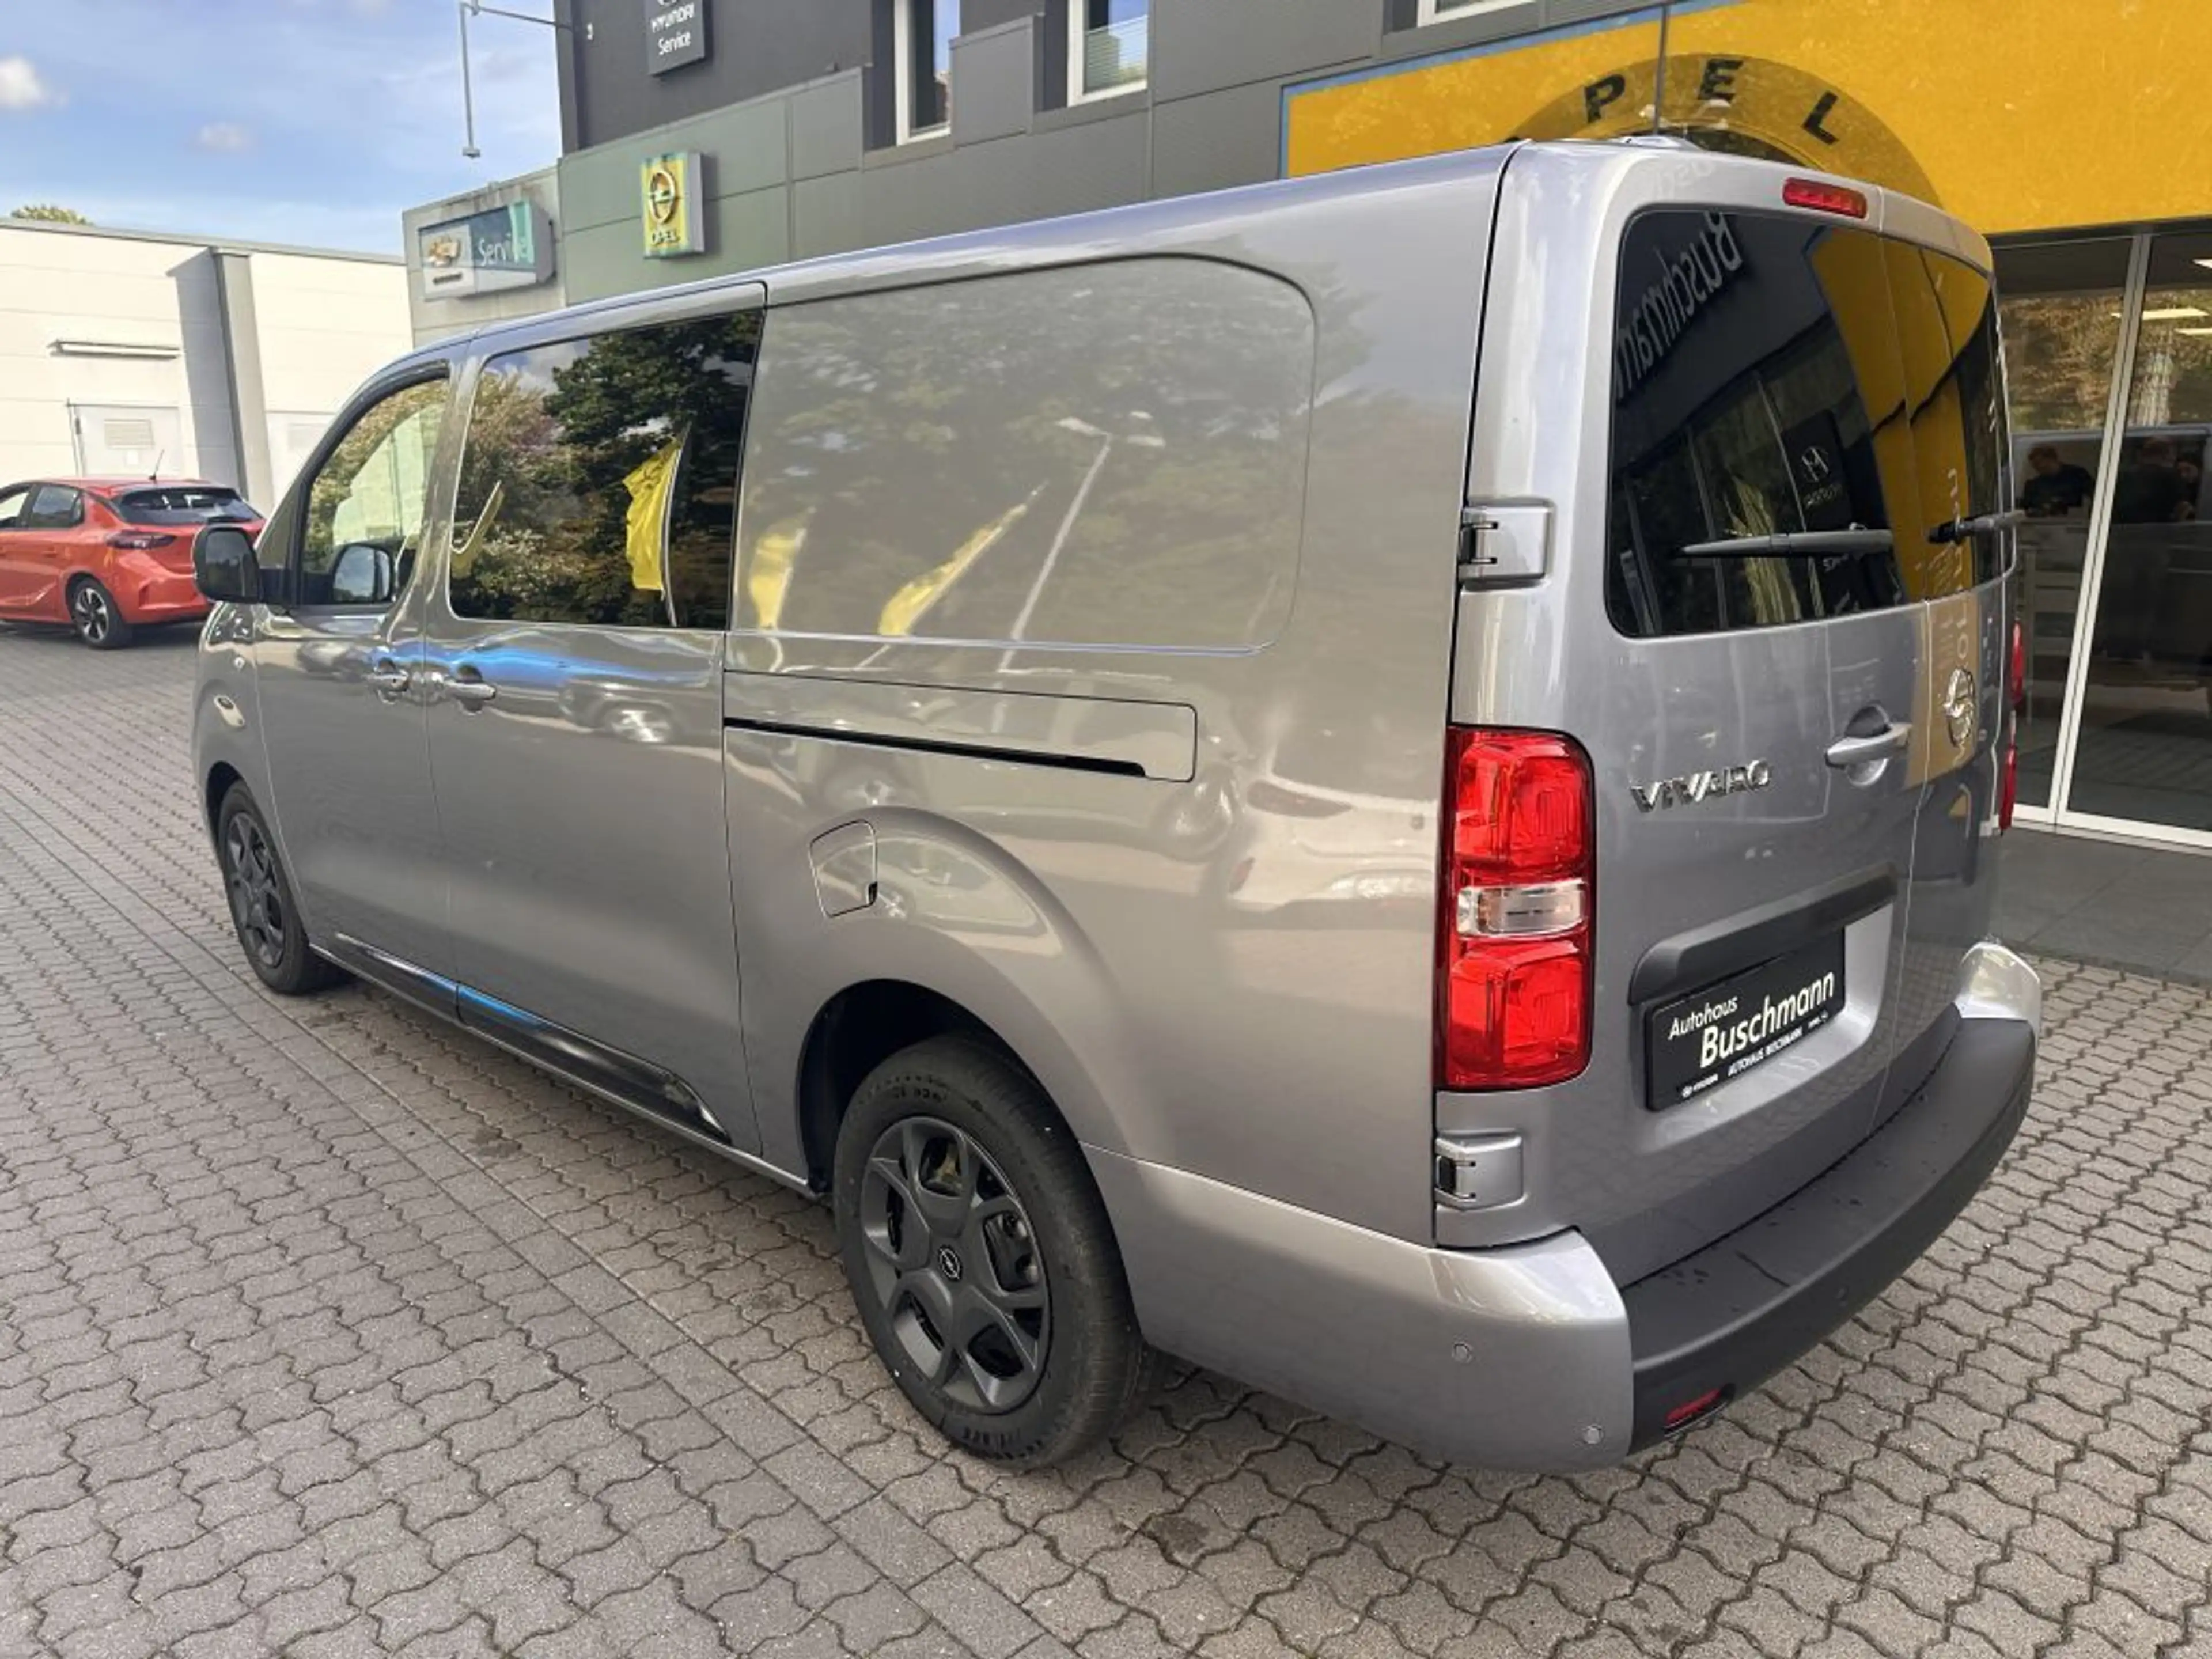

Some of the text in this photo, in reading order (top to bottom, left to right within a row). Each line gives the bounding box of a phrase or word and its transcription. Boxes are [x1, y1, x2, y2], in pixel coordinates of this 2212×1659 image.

[658, 31, 691, 55] Service
[1503, 59, 1839, 145] PEL
[1630, 759, 1771, 813] VIVARO
[1668, 996, 1737, 1040] Autohaus
[1700, 971, 1834, 1068] Buschmann
